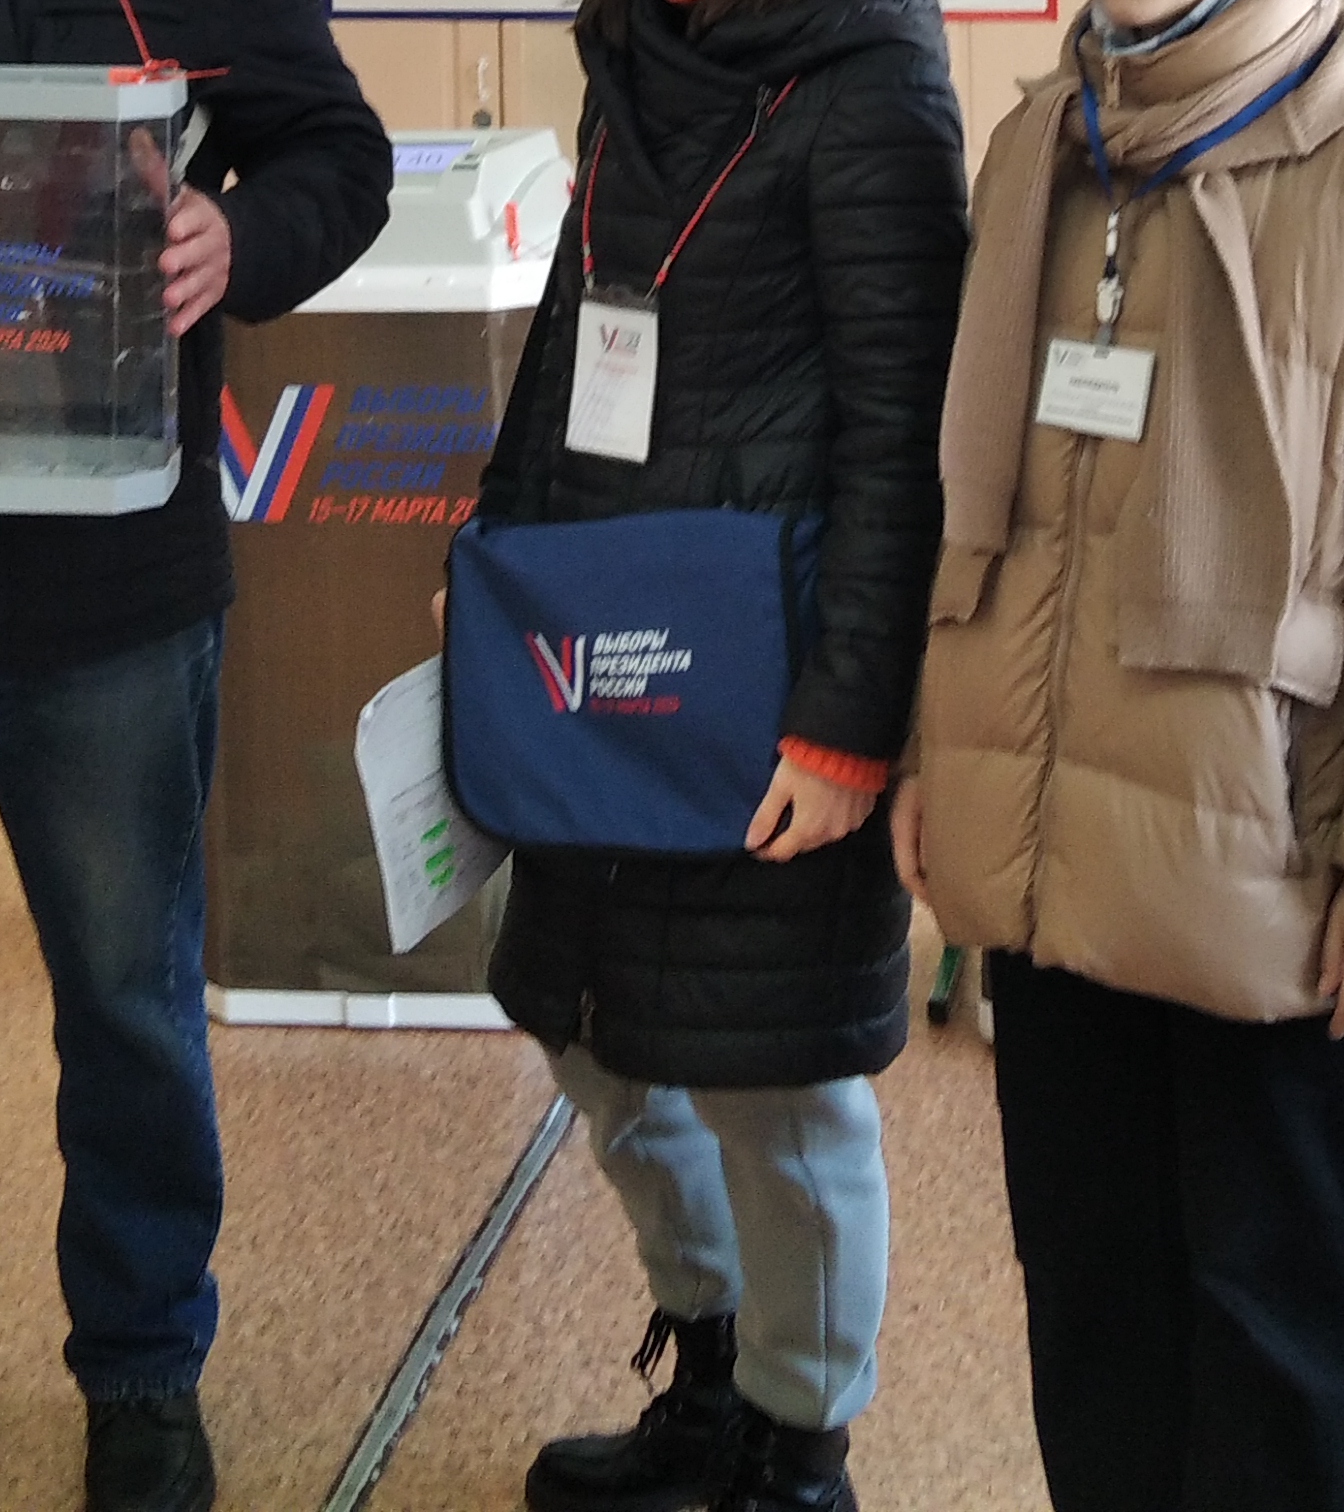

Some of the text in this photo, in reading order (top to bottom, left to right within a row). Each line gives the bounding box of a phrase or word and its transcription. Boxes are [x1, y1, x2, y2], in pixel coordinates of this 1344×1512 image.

[24, 329, 71, 353] 2024
[350, 384, 487, 415] ВЫБОРЫ
[335, 421, 501, 454] ПРЕЗИДЕН
[319, 460, 446, 490] РОССИИ
[370, 496, 448, 524] МАРТА
[592, 627, 669, 656] ВЫБОРЫ
[589, 648, 692, 677] ПРЕЗИДЕНТА
[589, 672, 648, 698] РОССИИ
